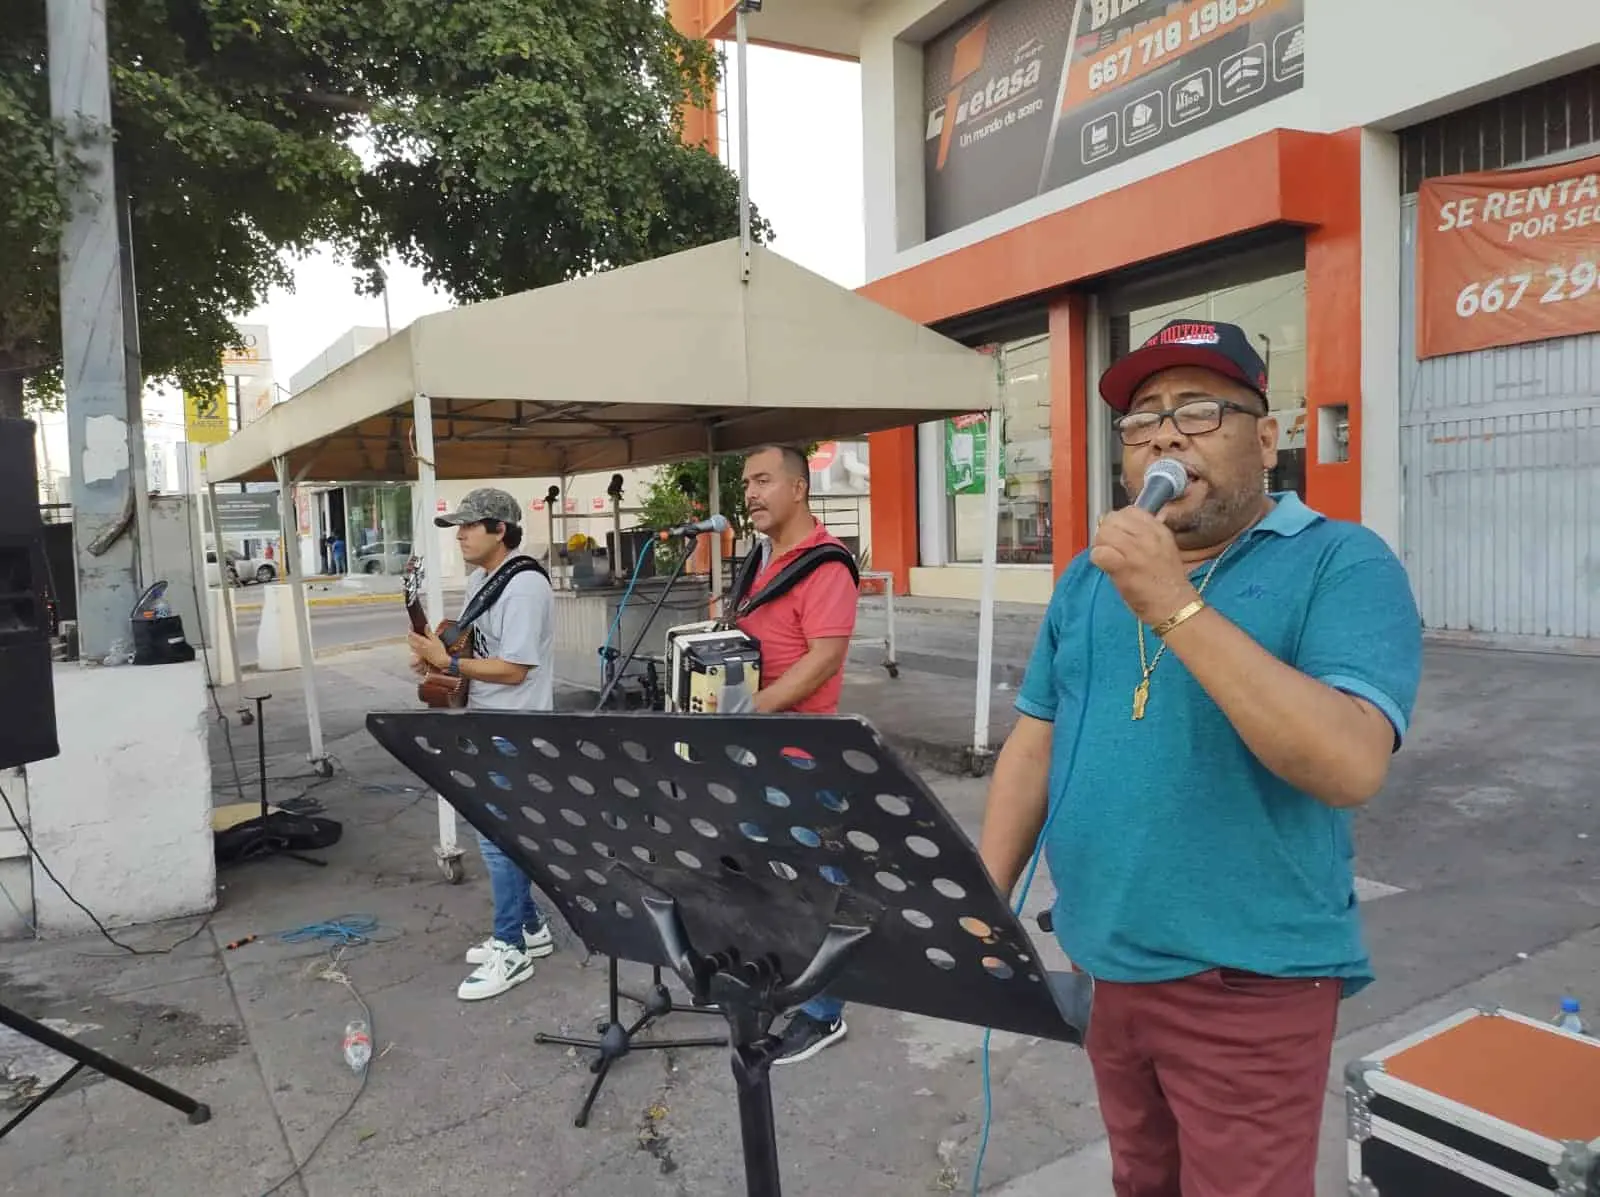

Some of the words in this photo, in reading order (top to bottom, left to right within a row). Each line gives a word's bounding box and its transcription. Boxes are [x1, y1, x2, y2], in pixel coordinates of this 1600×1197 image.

[1089, 45, 1132, 90] 667
[1138, 20, 1182, 65] 718
[973, 118, 1003, 141] mundo
[1004, 110, 1016, 126] de
[1017, 99, 1043, 120] acero
[1437, 198, 1478, 231] SE
[1507, 213, 1558, 242] POR
[1456, 272, 1532, 317] 667
[1539, 261, 1600, 304] 29
